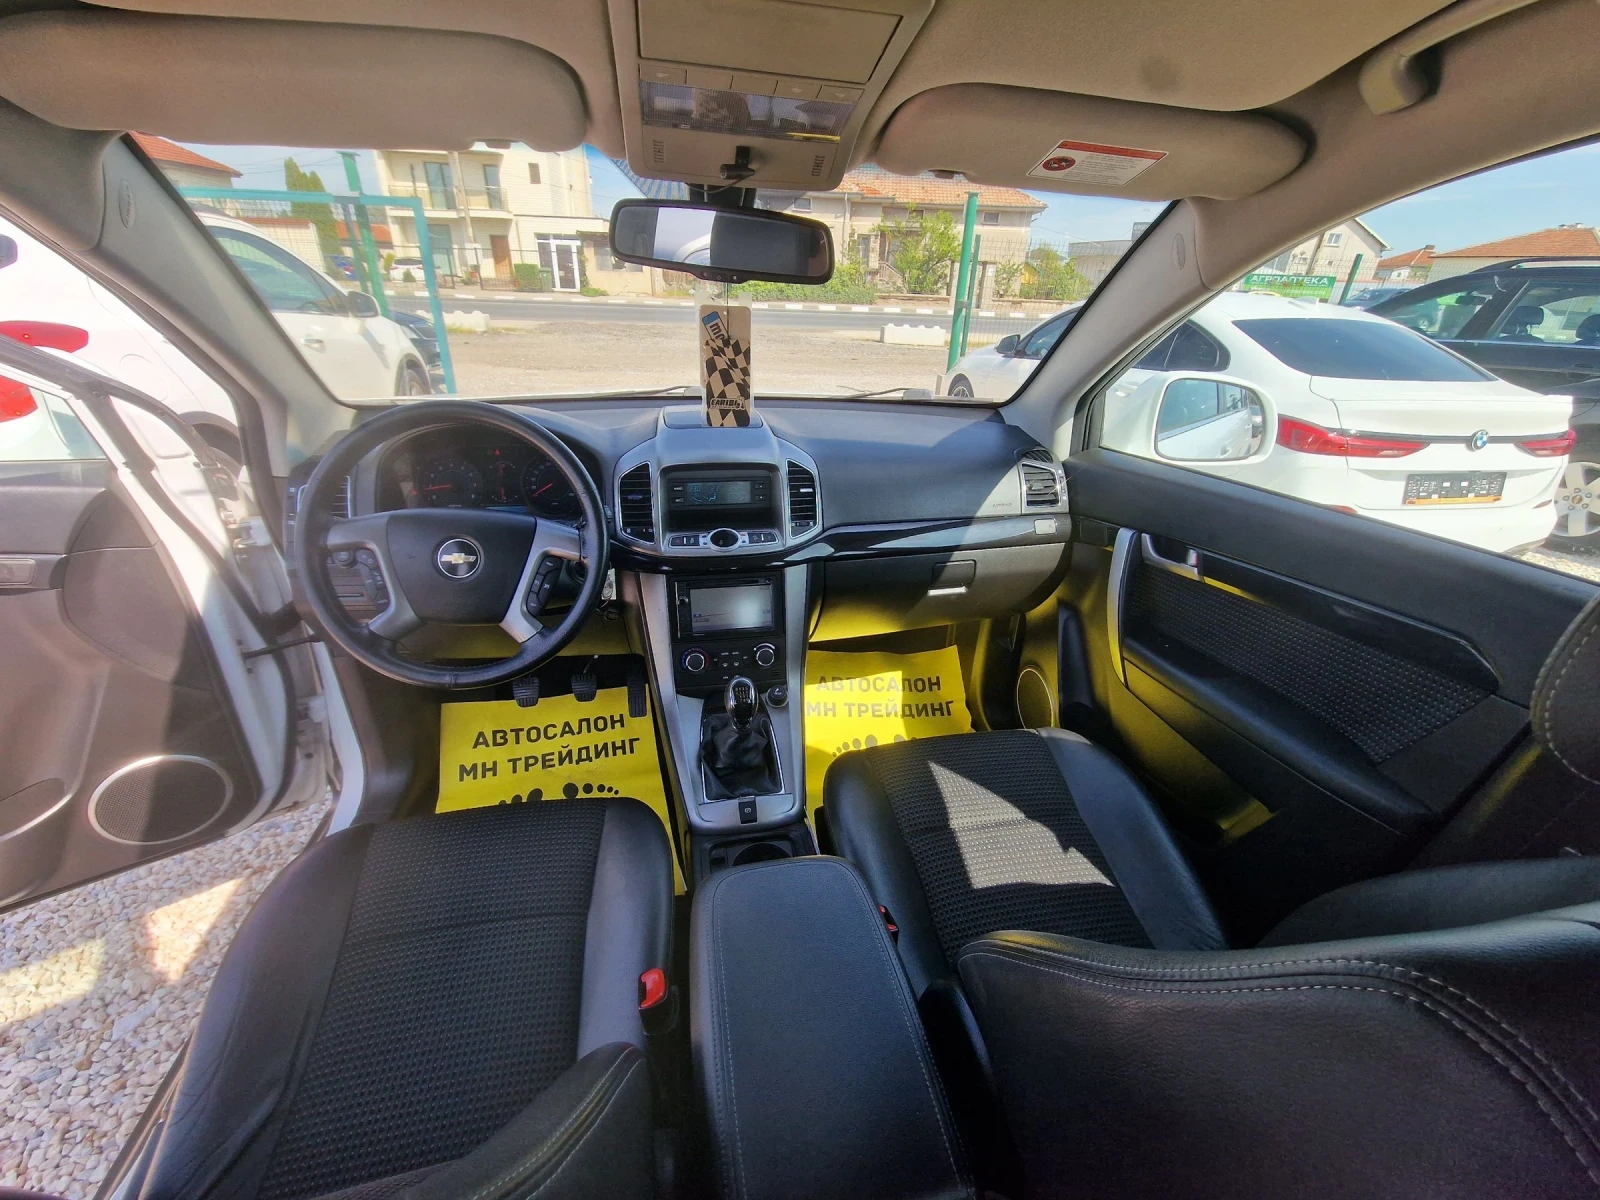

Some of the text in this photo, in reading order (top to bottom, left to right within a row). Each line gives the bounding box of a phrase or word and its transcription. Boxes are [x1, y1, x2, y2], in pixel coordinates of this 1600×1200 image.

[1250, 275, 1329, 285] АГРОАПТЕКА
[816, 675, 941, 693] АВТОСАЛОН
[806, 698, 954, 719] МН ТРЕЙДИНГ
[472, 713, 625, 749] АВТОСАЛОН
[458, 737, 640, 782] МН ТРЕЙДИНГ
